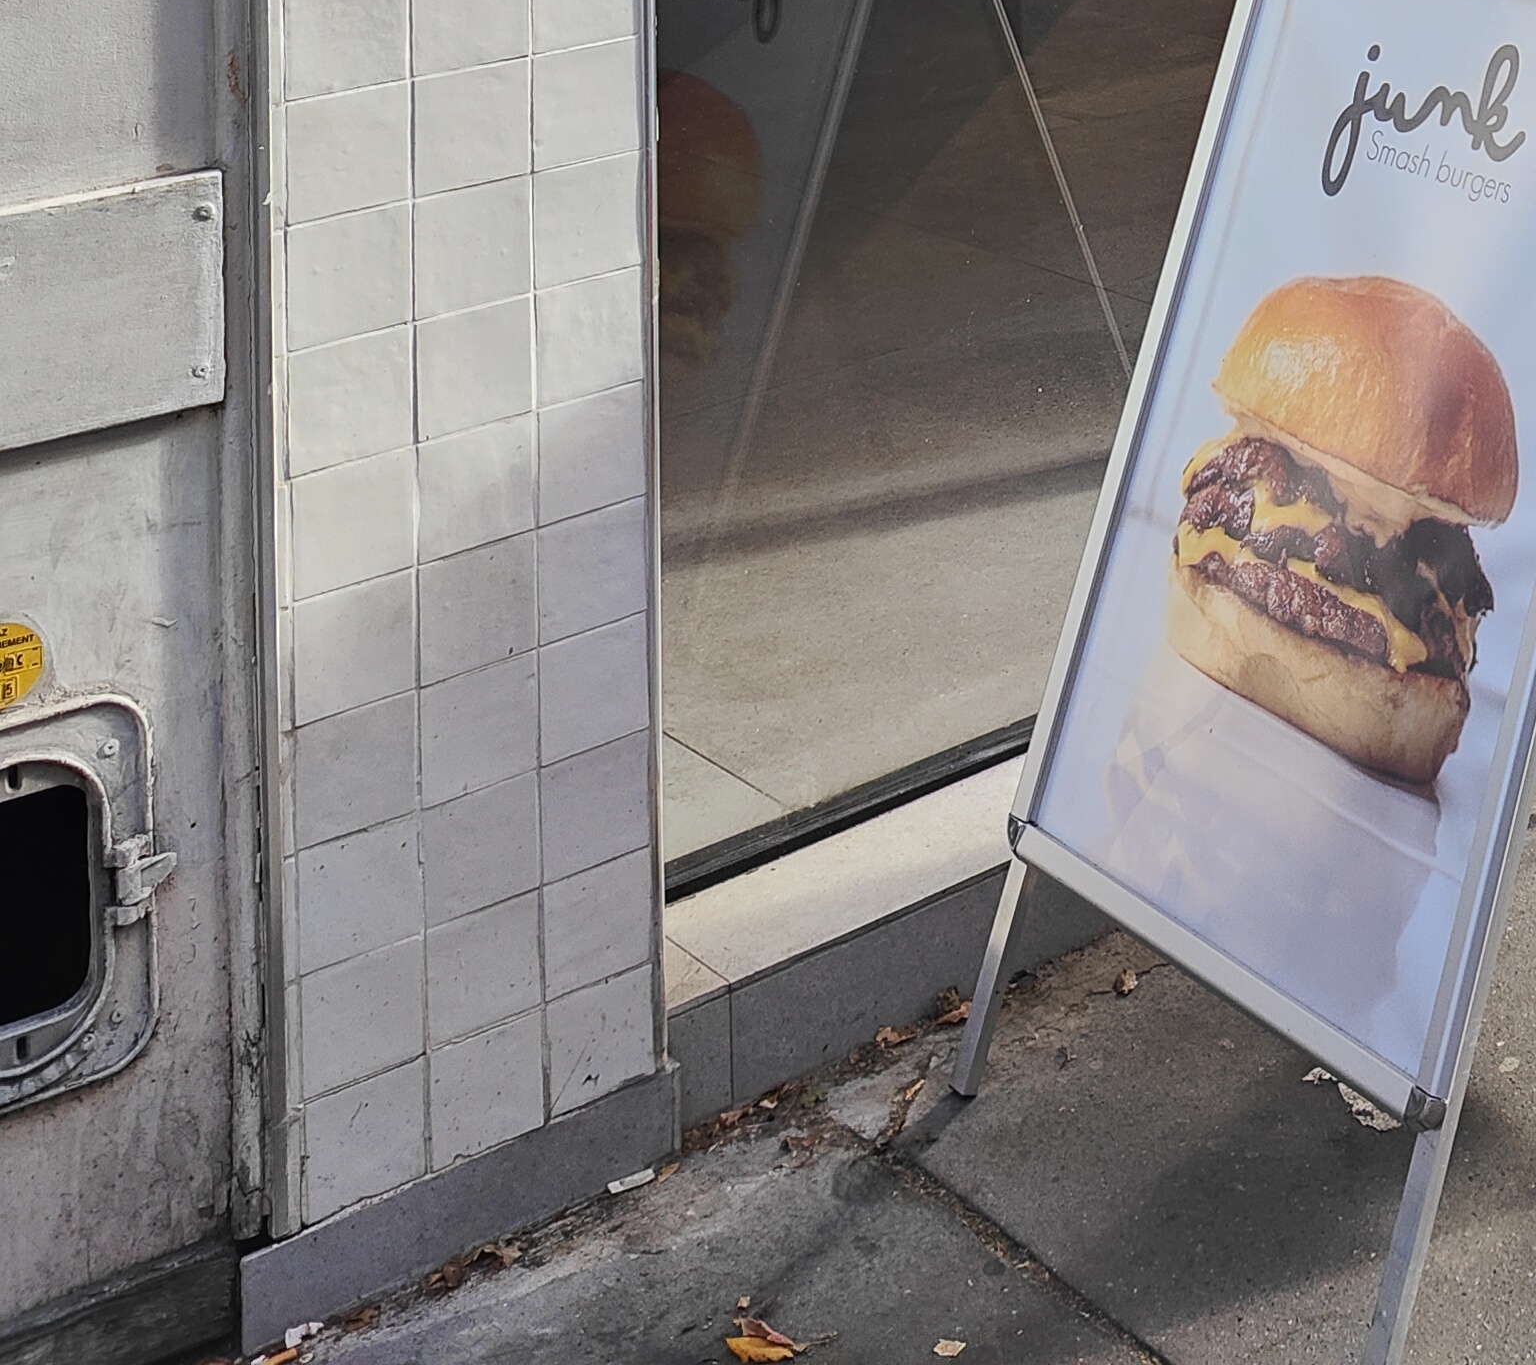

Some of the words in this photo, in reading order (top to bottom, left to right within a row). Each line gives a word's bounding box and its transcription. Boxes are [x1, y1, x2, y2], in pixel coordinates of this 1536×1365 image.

[1321, 44, 1526, 197] junk
[1366, 129, 1432, 178] Smash
[1436, 150, 1512, 203] burgers
[0, 633, 35, 649] EMENT
